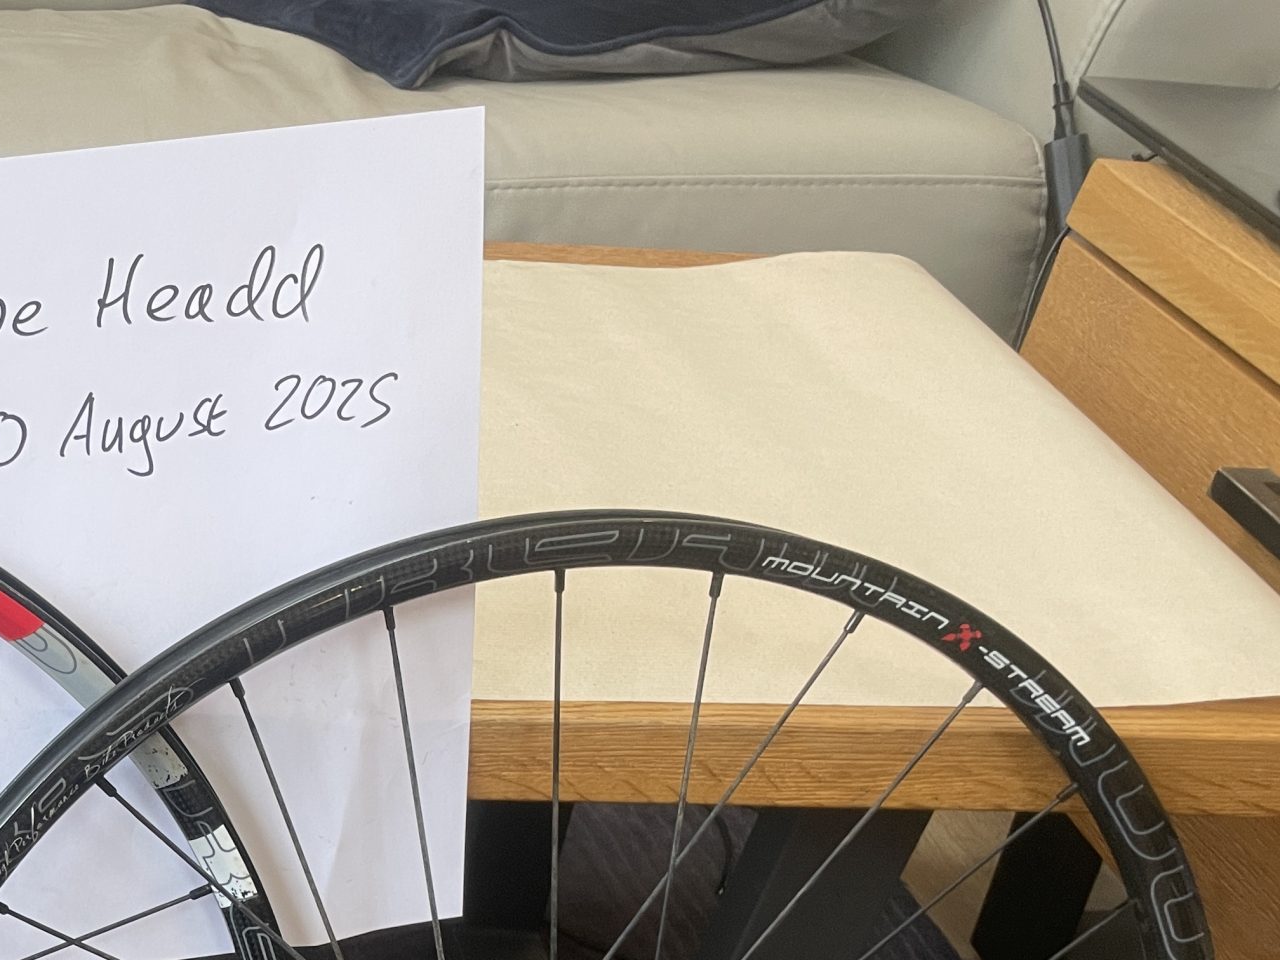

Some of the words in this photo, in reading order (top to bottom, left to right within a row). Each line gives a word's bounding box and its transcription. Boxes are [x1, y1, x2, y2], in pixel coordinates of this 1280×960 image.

[96, 243, 325, 329] Headd
[59, 391, 229, 477] August
[264, 371, 399, 431] 2025
